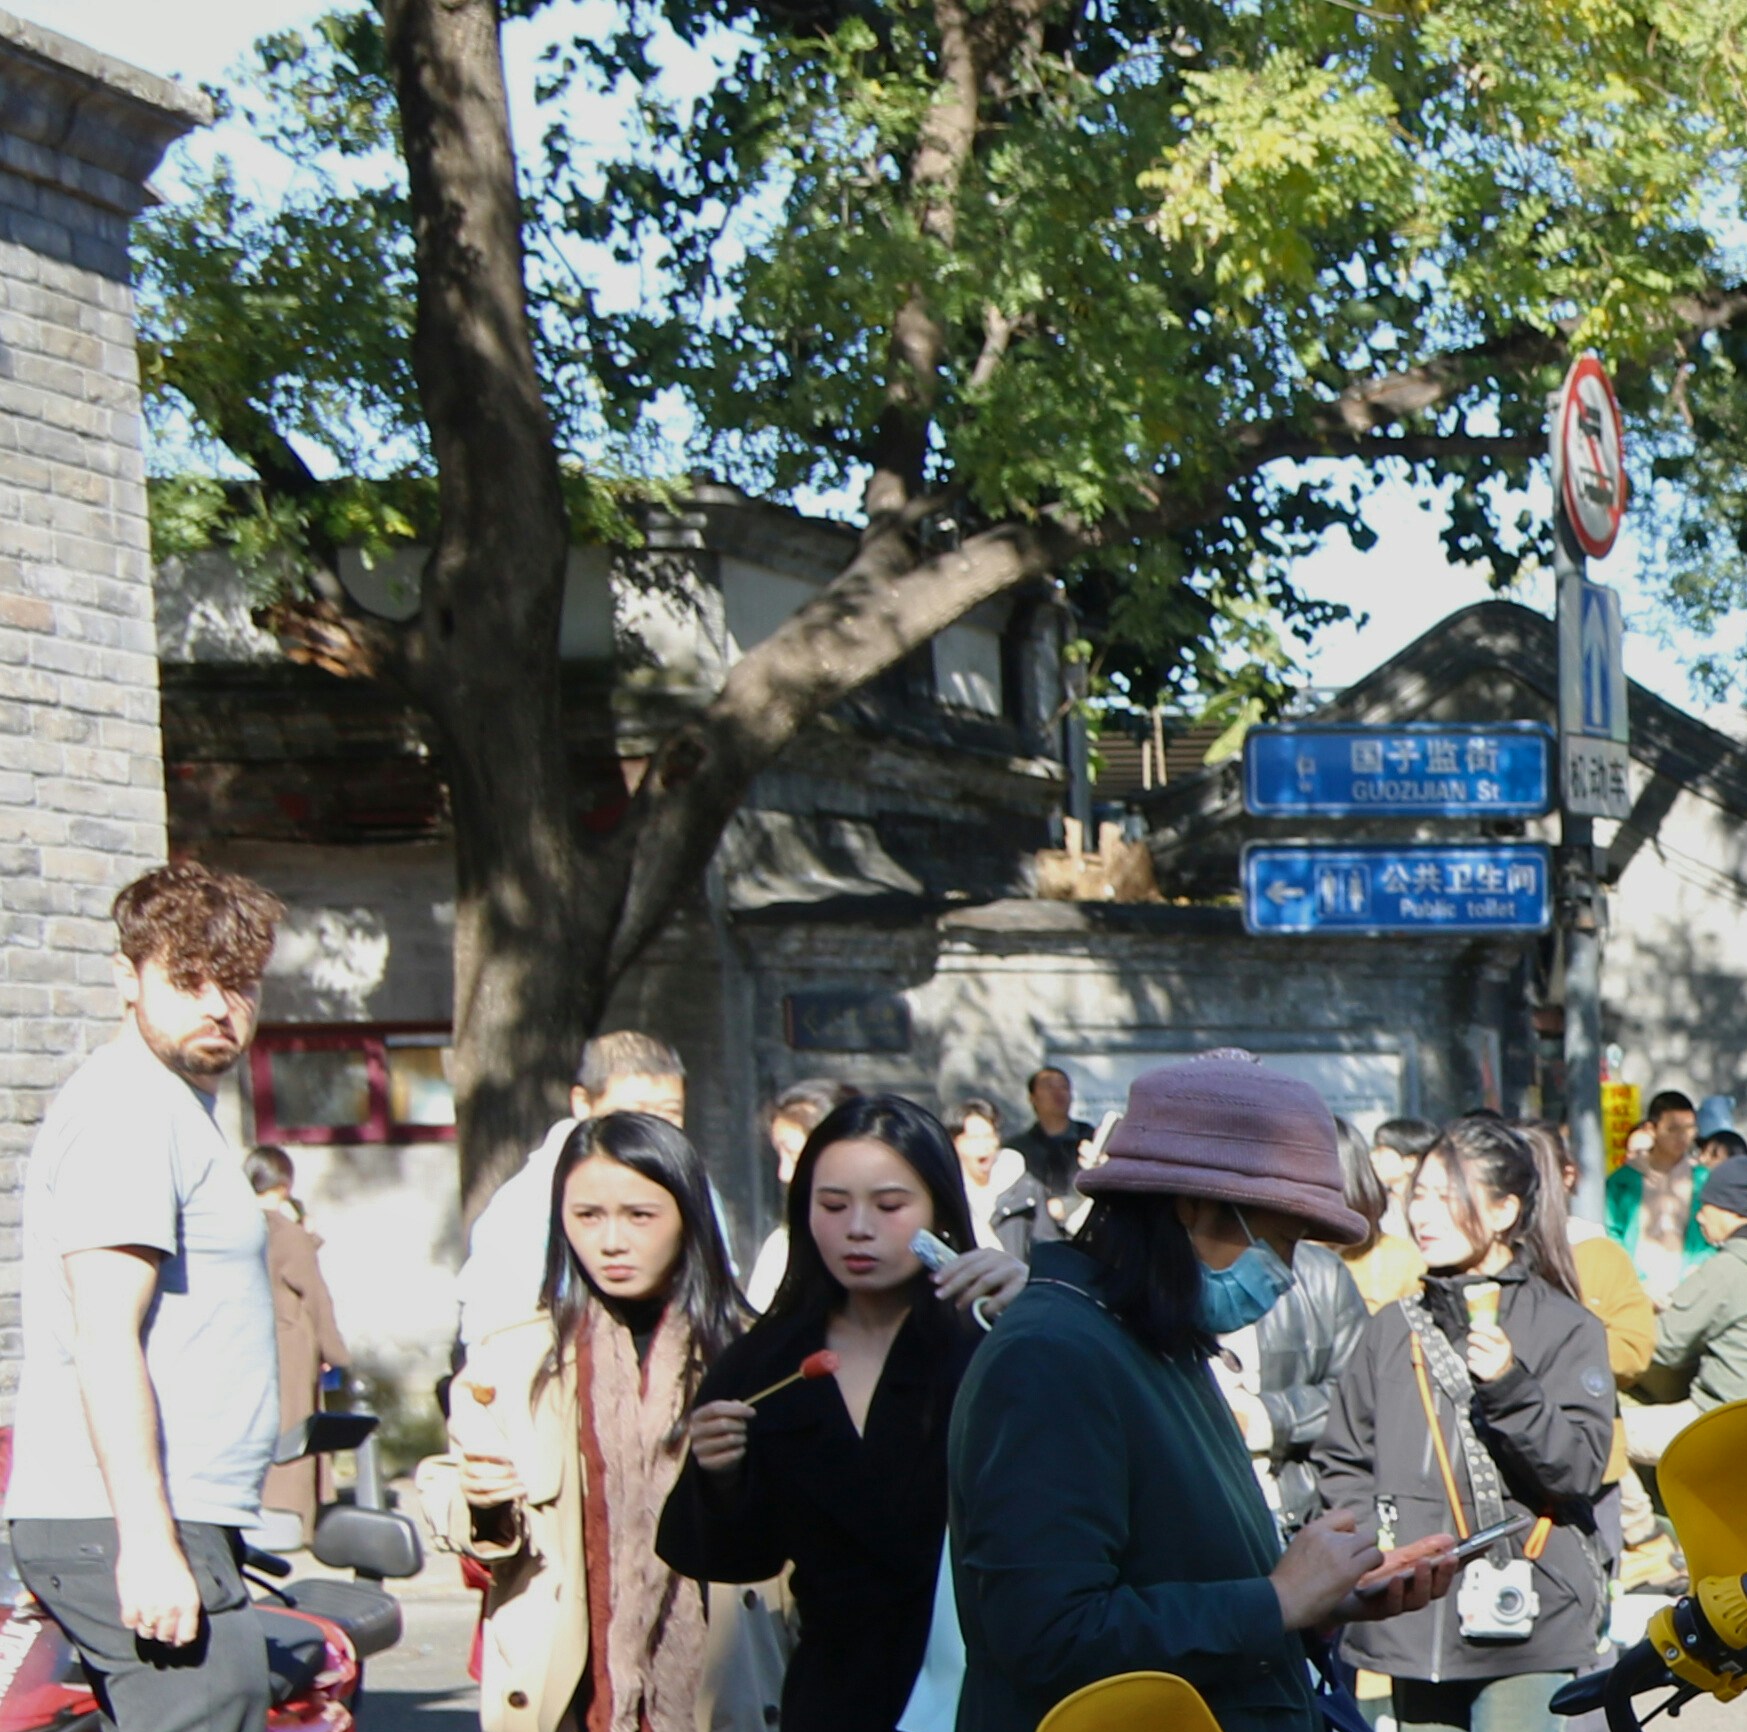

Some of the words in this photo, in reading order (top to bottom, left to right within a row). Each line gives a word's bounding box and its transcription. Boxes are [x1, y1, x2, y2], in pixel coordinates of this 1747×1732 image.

[1351, 738, 1498, 774] 国子监街
[1353, 780, 1467, 800] GUOZIJIAN
[1477, 781, 1499, 800] St
[1572, 754, 1625, 803] 机动车
[1382, 863, 1537, 895] 公共卫生间
[1400, 899, 1456, 918] Public
[1468, 899, 1515, 918] toilet
